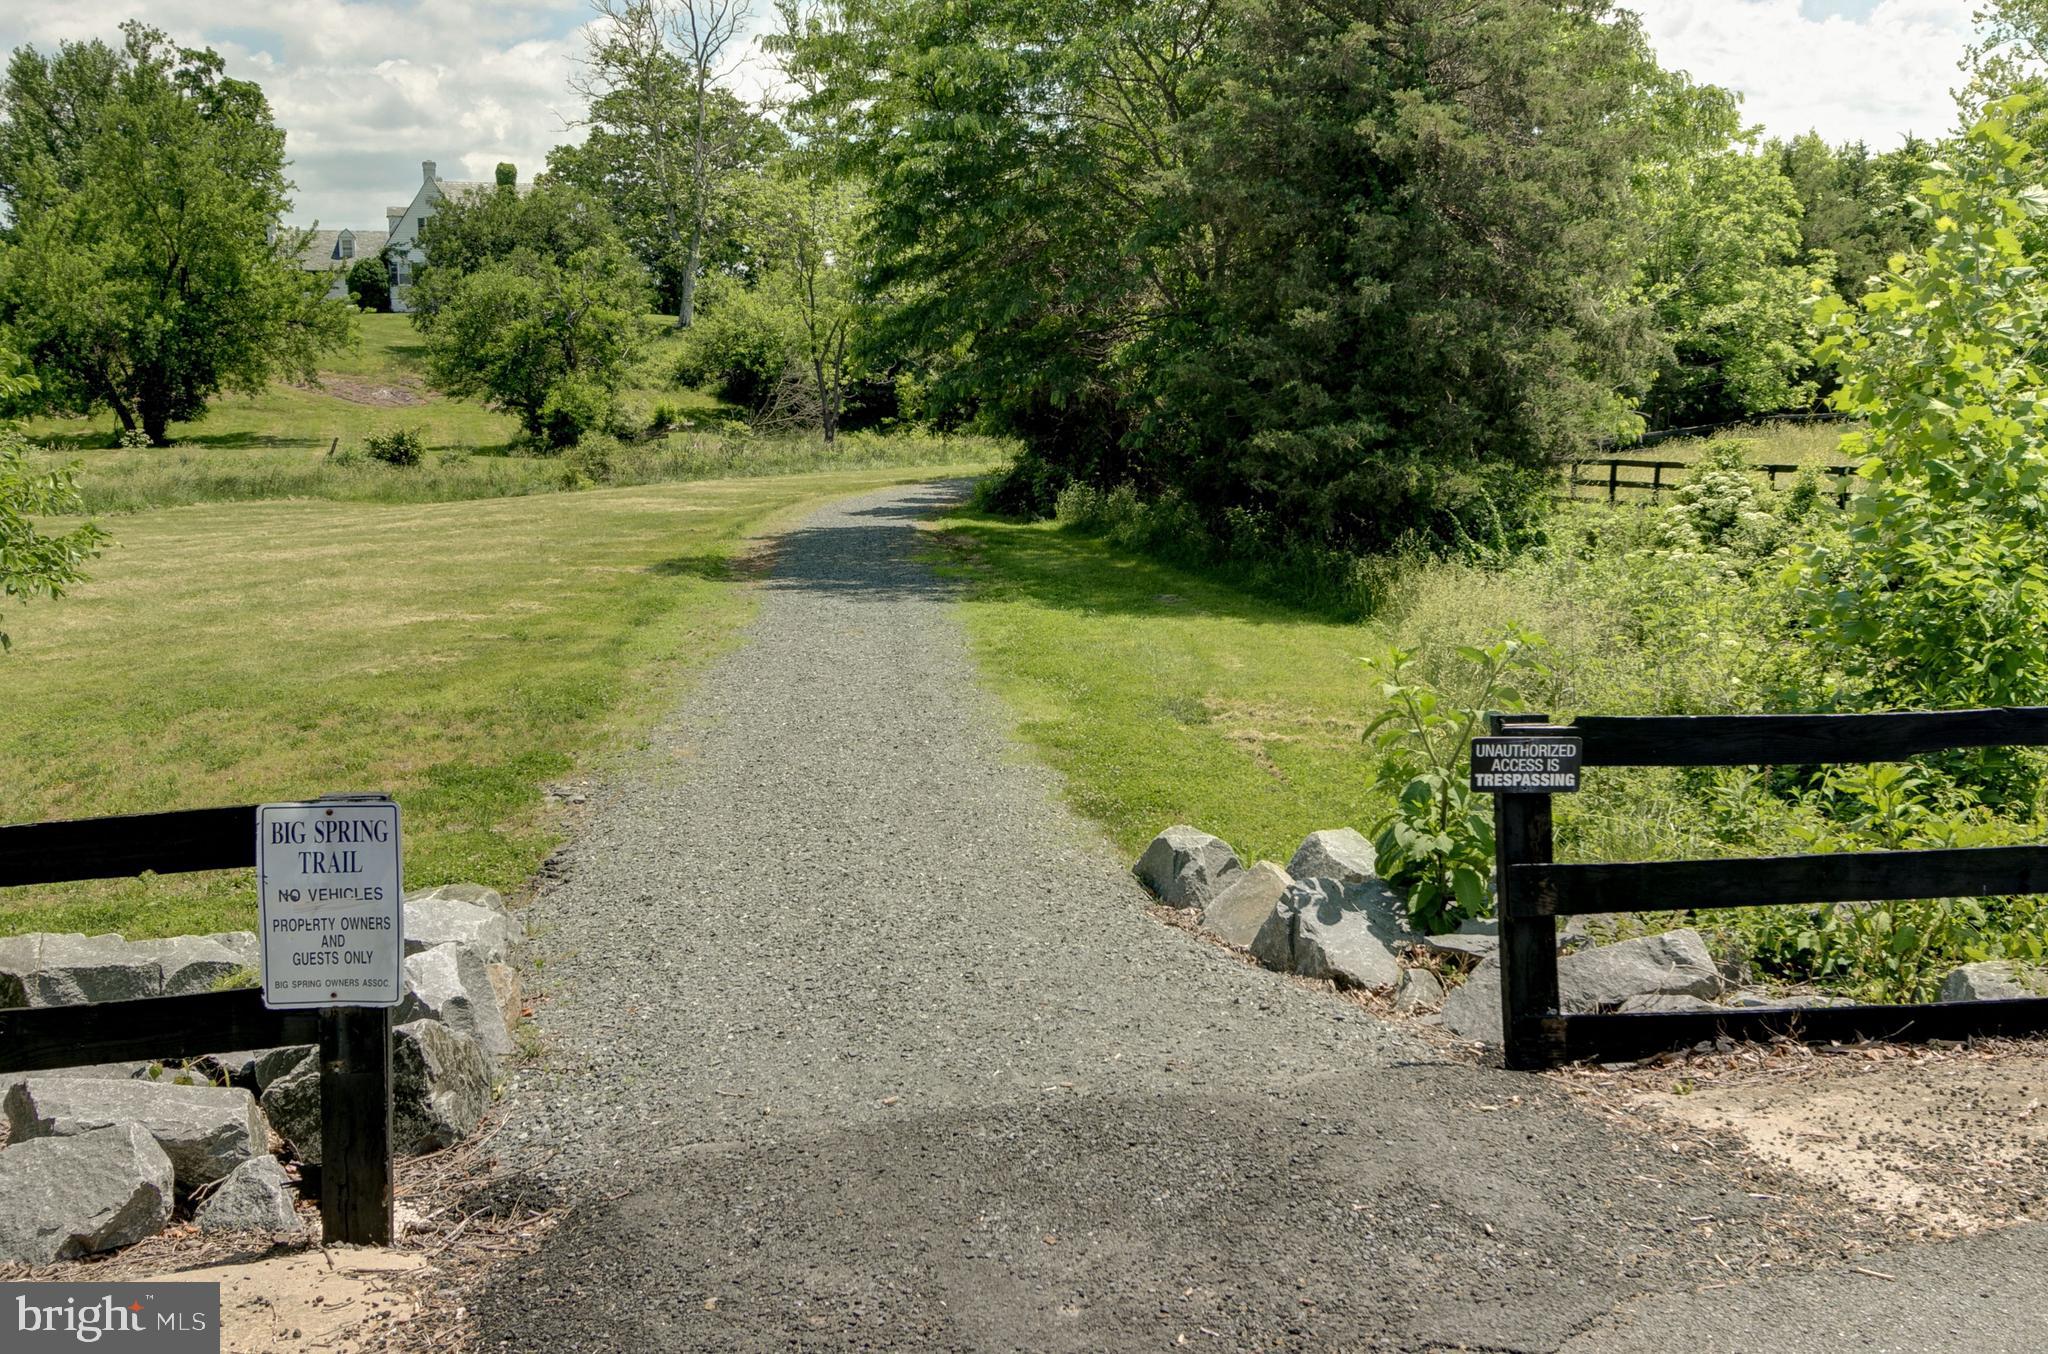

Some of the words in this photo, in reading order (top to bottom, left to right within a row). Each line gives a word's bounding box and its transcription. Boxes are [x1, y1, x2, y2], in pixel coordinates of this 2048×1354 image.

[1475, 744, 1577, 758] UNAUTHORIZED
[1491, 758, 1544, 772] ACCESS
[1547, 758, 1560, 772] IS
[1474, 773, 1576, 787] TRESPASSING
[271, 821, 306, 845] BIG
[314, 819, 389, 844] SPRING
[298, 850, 363, 874] TRAIL
[278, 888, 301, 903] NO
[308, 886, 383, 902] VEHICLES
[273, 917, 336, 932] PROPERTY
[340, 916, 391, 931] OWNERS
[321, 934, 346, 948] AND
[292, 951, 339, 966] GUESTS
[344, 951, 373, 965] ONLY
[274, 980, 289, 989] BIG
[291, 979, 322, 988] SPRING
[325, 978, 360, 988] OWNERS
